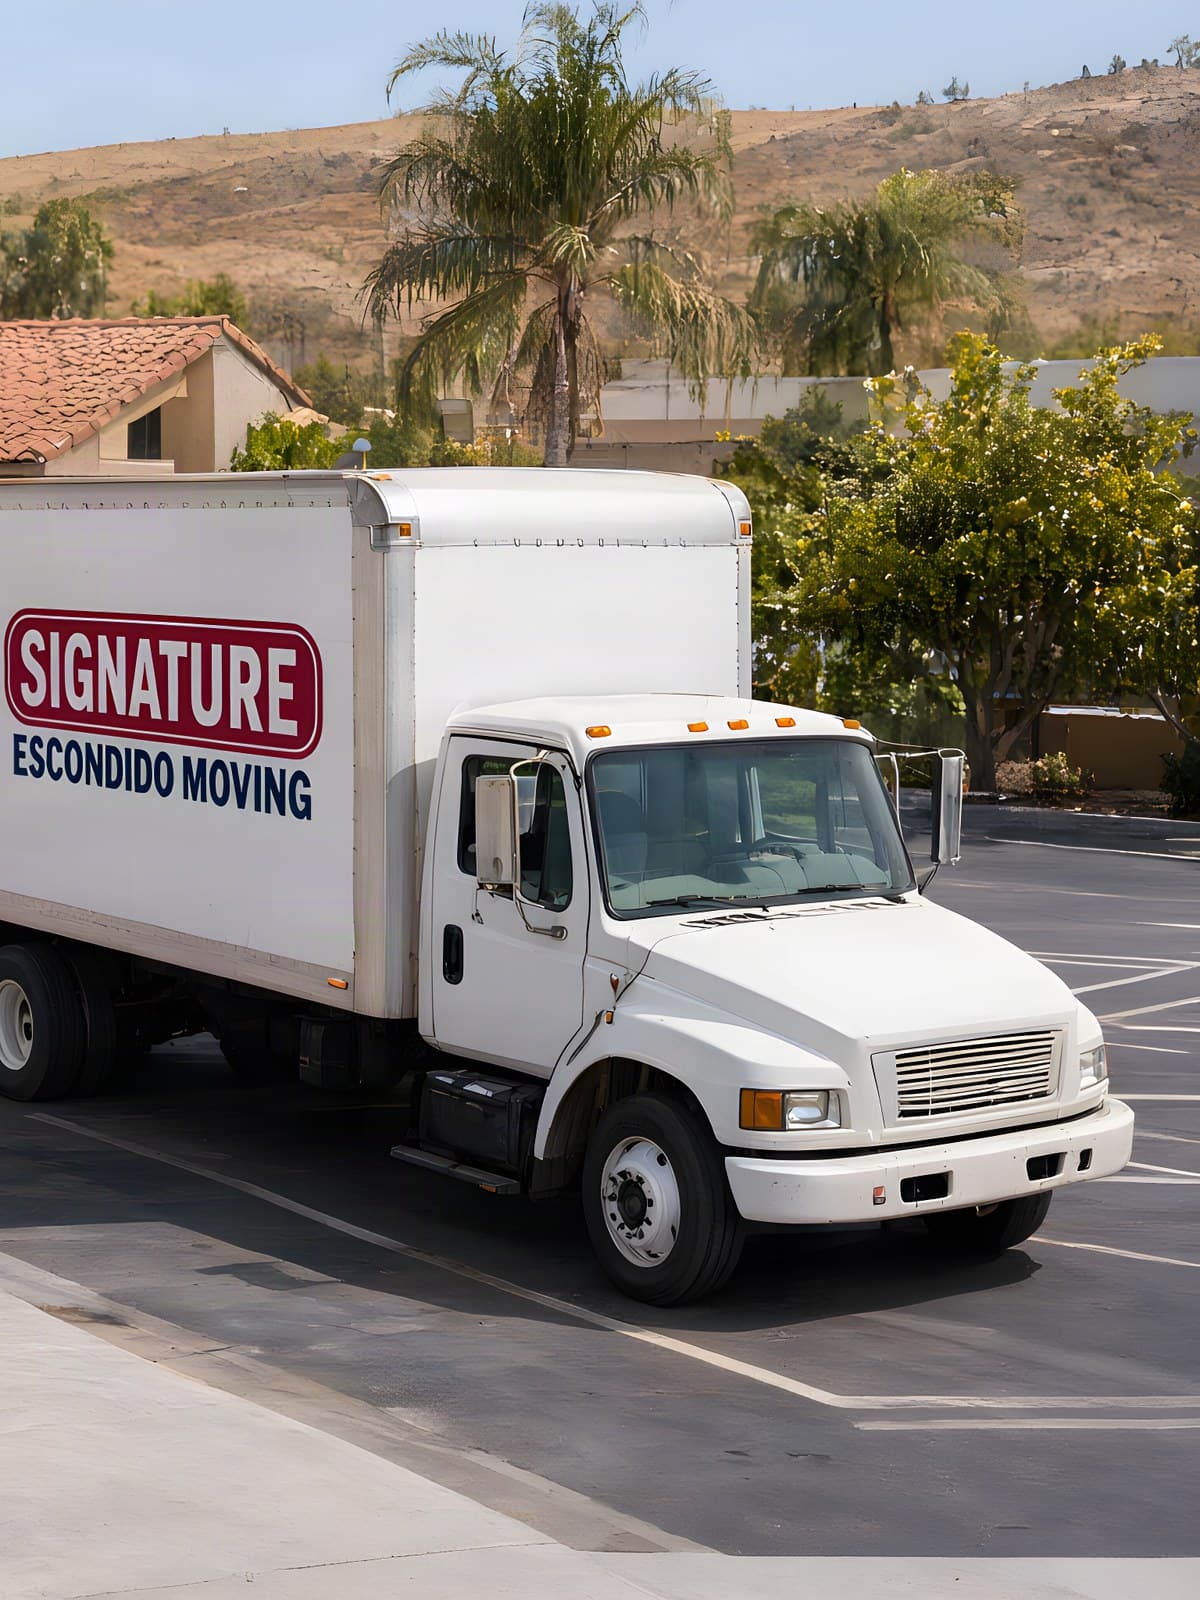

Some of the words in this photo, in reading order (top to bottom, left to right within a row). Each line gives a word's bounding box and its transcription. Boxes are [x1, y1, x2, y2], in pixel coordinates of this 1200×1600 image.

[20, 629, 298, 736] SIGNATURE
[13, 734, 174, 797] ESCONDIDO
[183, 757, 312, 820] MOVING
